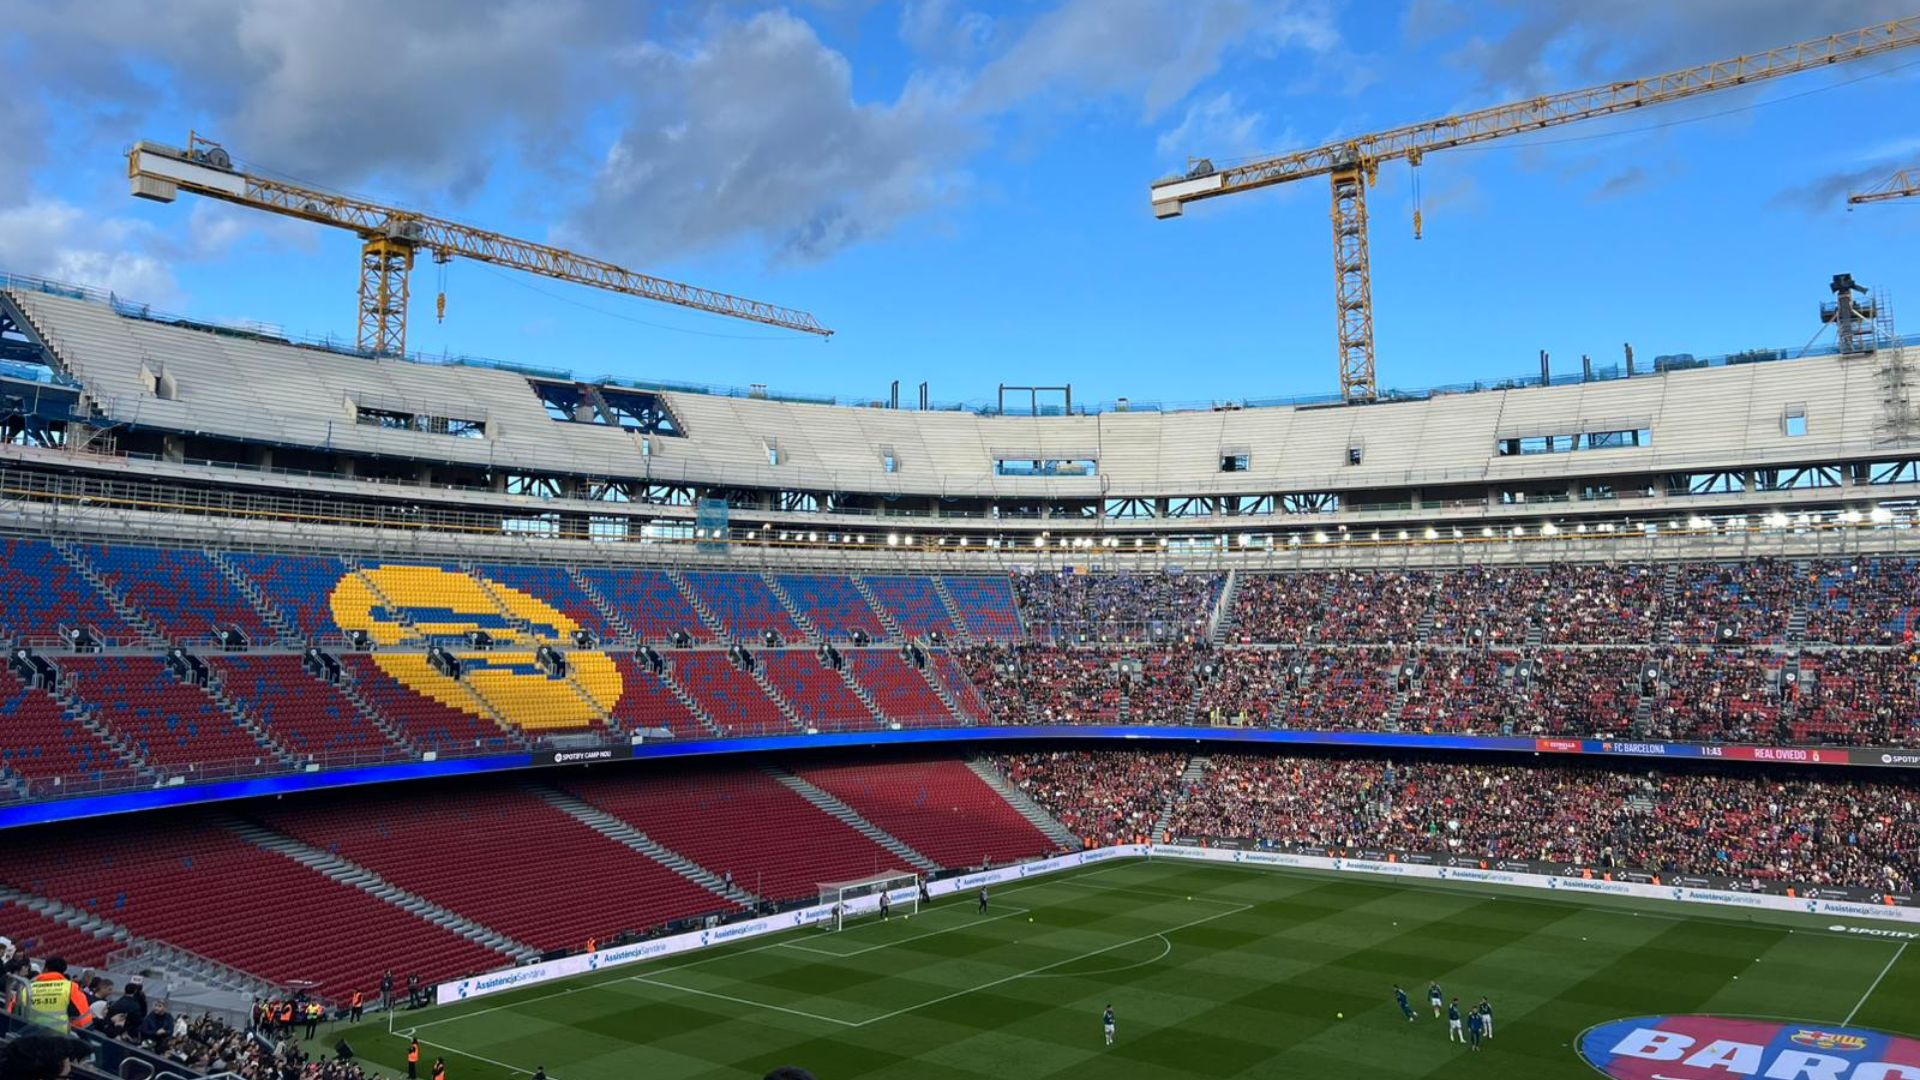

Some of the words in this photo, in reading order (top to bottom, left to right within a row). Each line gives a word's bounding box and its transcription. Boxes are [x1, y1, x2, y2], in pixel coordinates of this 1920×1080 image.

[1614, 742, 1624, 752] FC
[1624, 743, 1665, 753] BARCELONA
[562, 753, 584, 761] SPOTIFY
[584, 751, 599, 759] CAMP
[1754, 748, 1775, 759] REAL
[1776, 750, 1806, 760] OVIEDO
[1892, 755, 1920, 763] SPOTIF
[1846, 927, 1920, 939] SPOTIFY
